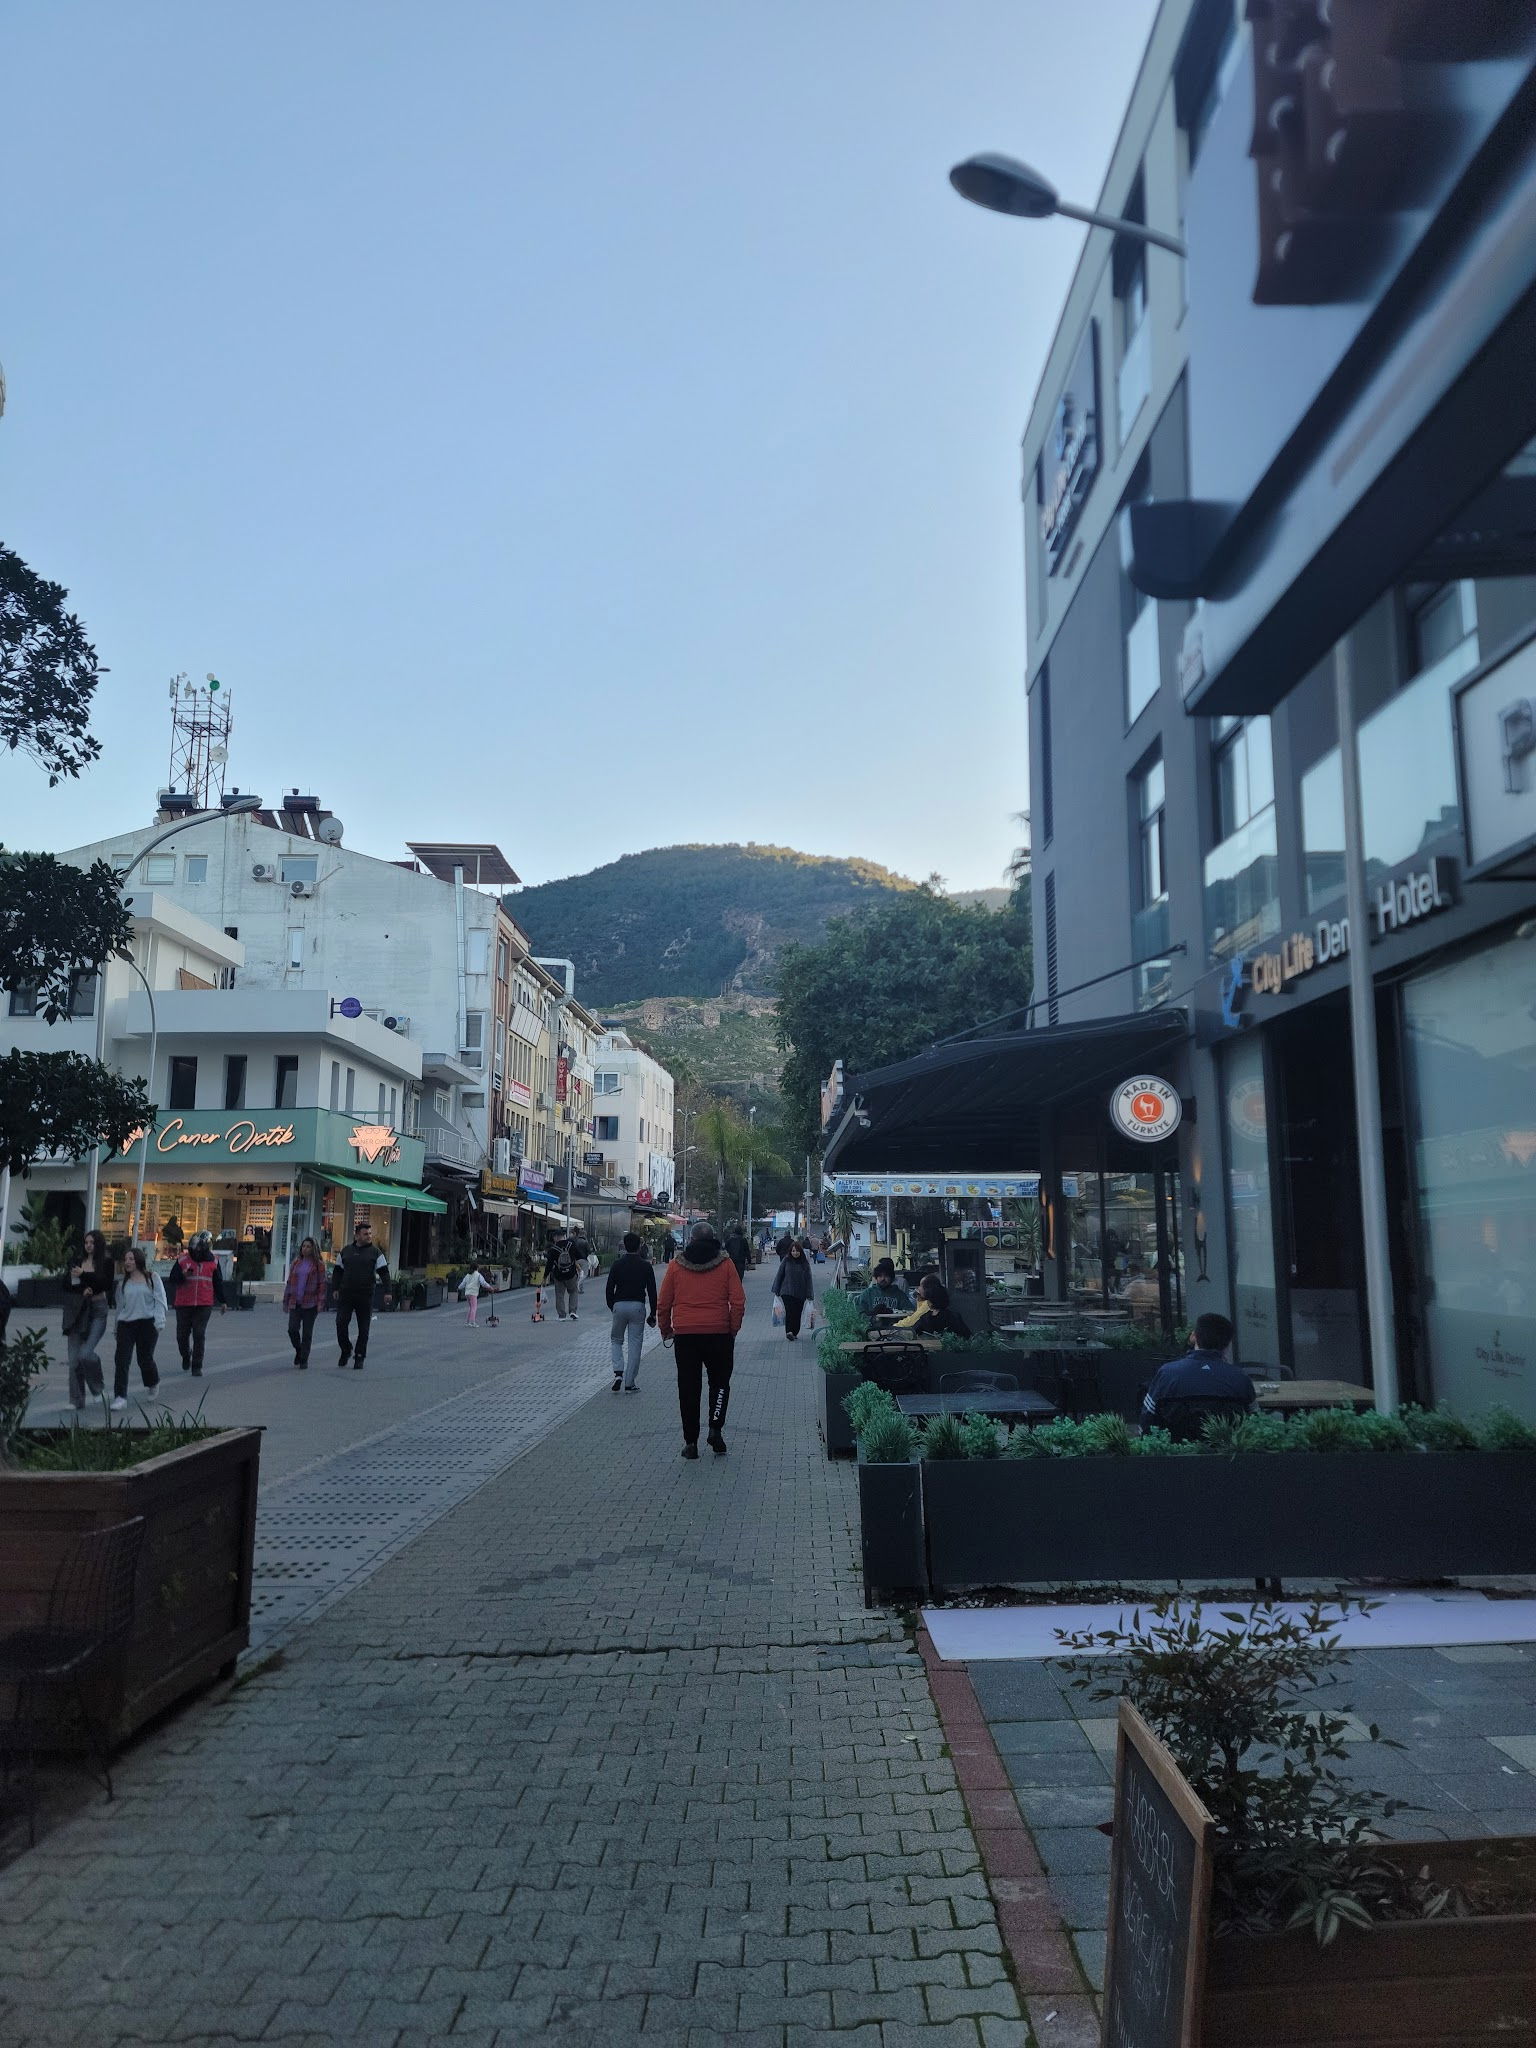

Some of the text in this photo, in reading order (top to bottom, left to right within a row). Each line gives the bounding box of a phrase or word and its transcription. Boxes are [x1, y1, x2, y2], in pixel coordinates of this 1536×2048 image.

[1252, 952, 1281, 995] City
[1282, 932, 1314, 979] Life
[1377, 856, 1442, 934] Hotel
[1123, 1081, 1172, 1100] MADE IN
[157, 1118, 296, 1153] Caner Optik
[713, 1388, 725, 1421] NAUTICA
